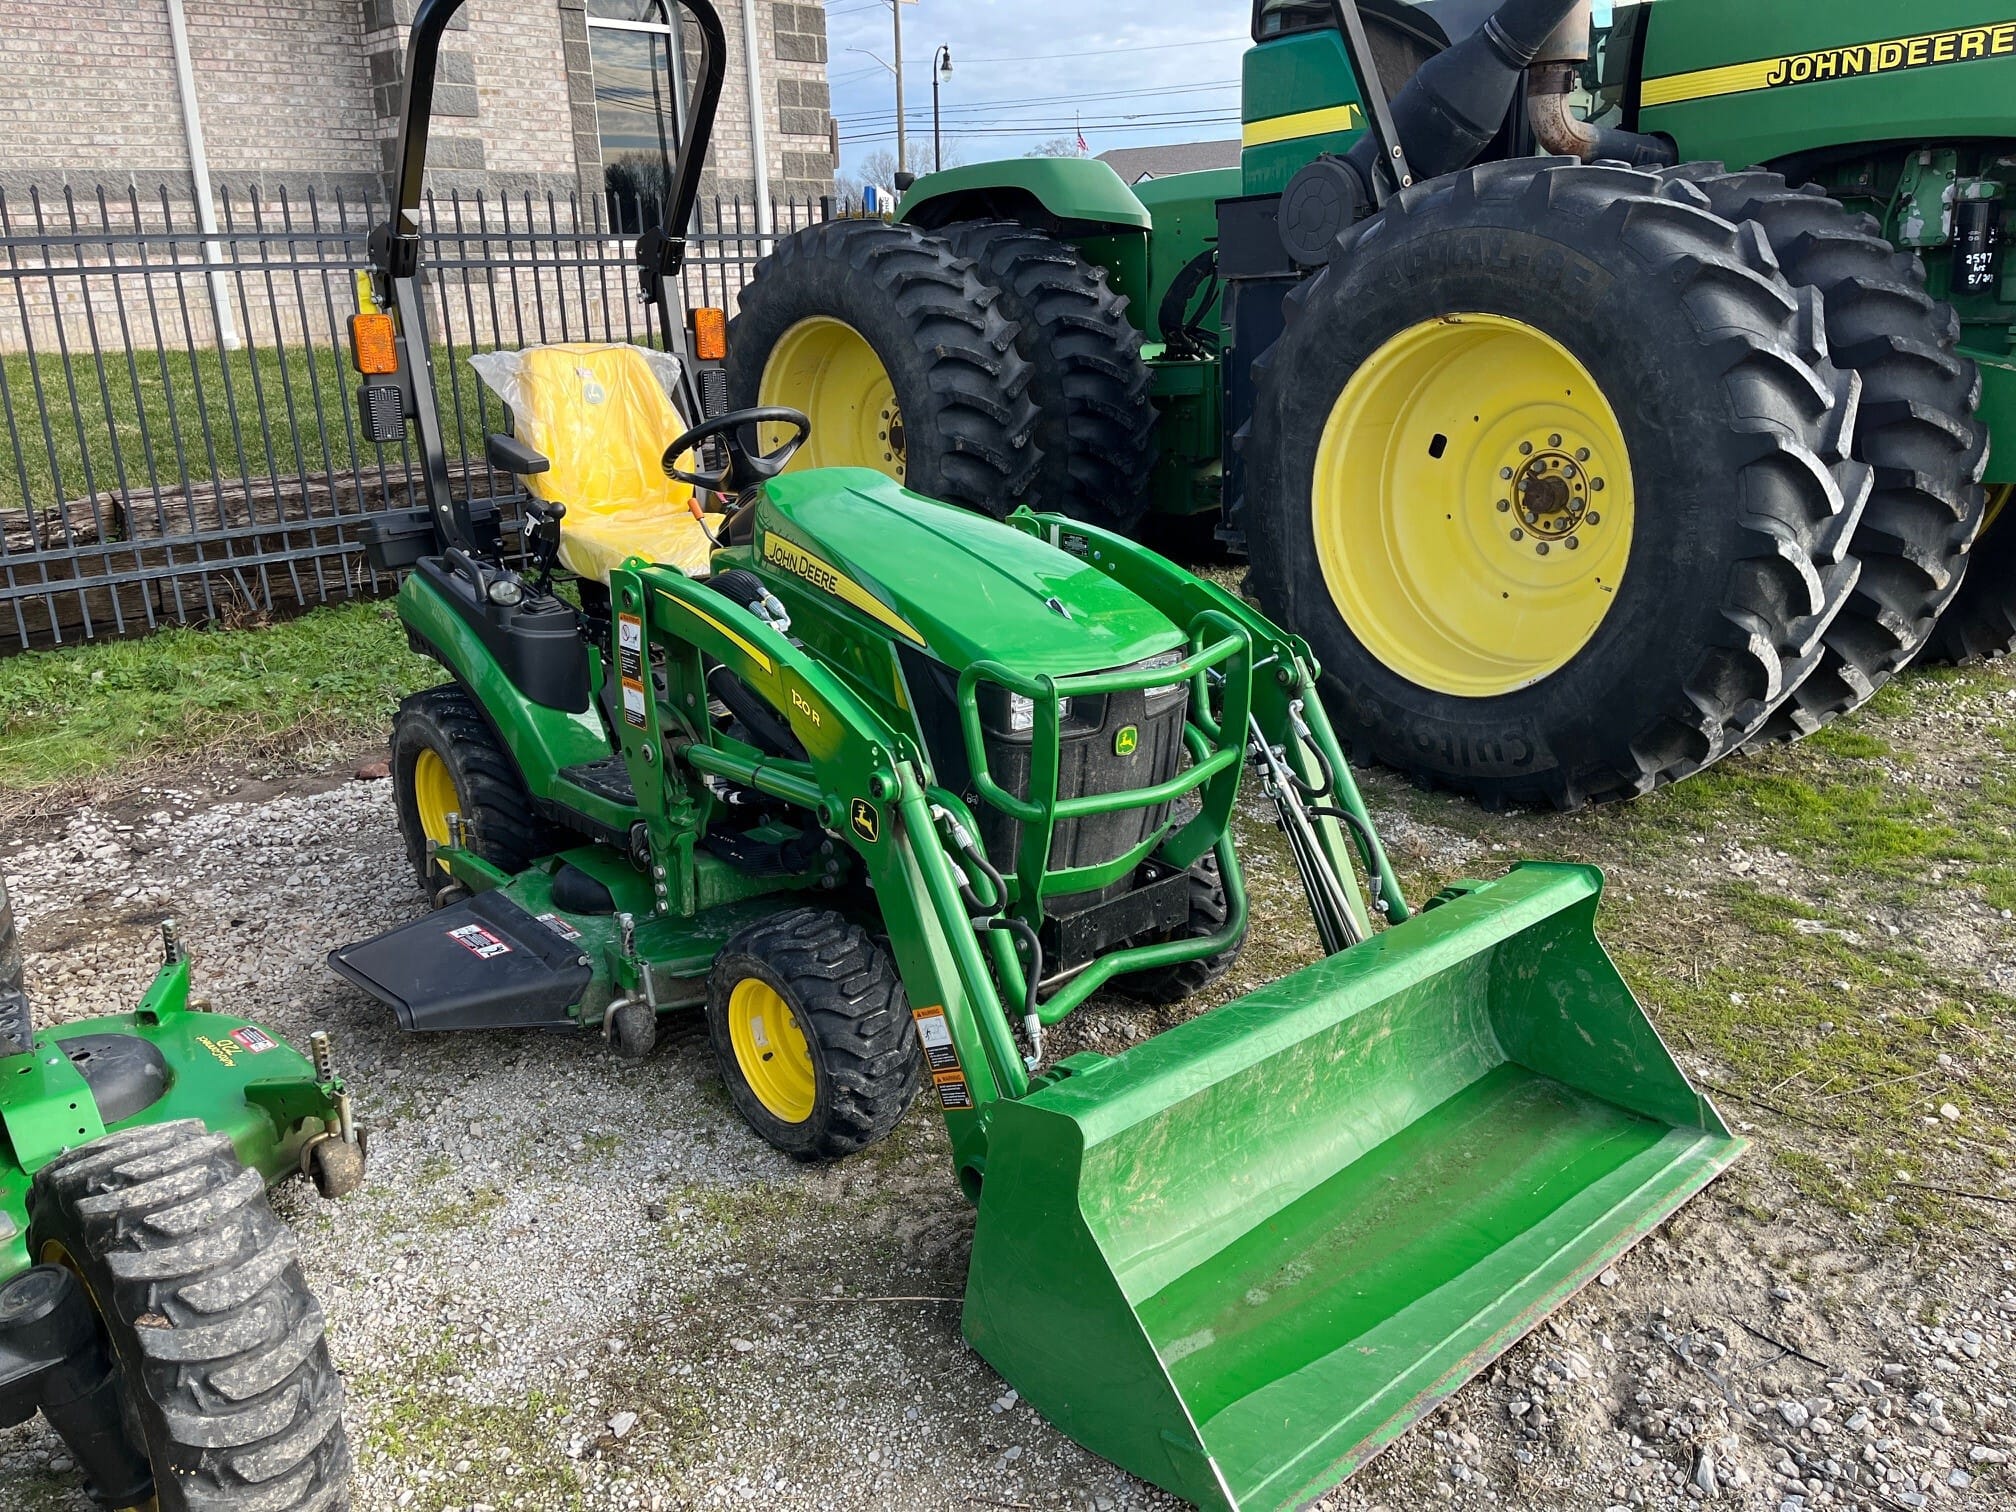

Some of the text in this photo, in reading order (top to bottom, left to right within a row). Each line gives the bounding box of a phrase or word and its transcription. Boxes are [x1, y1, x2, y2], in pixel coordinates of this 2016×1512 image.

[1767, 26, 2016, 86] JOHN DEERE
[1966, 252, 1993, 265] 2597
[769, 543, 838, 593] JOHN DEERE
